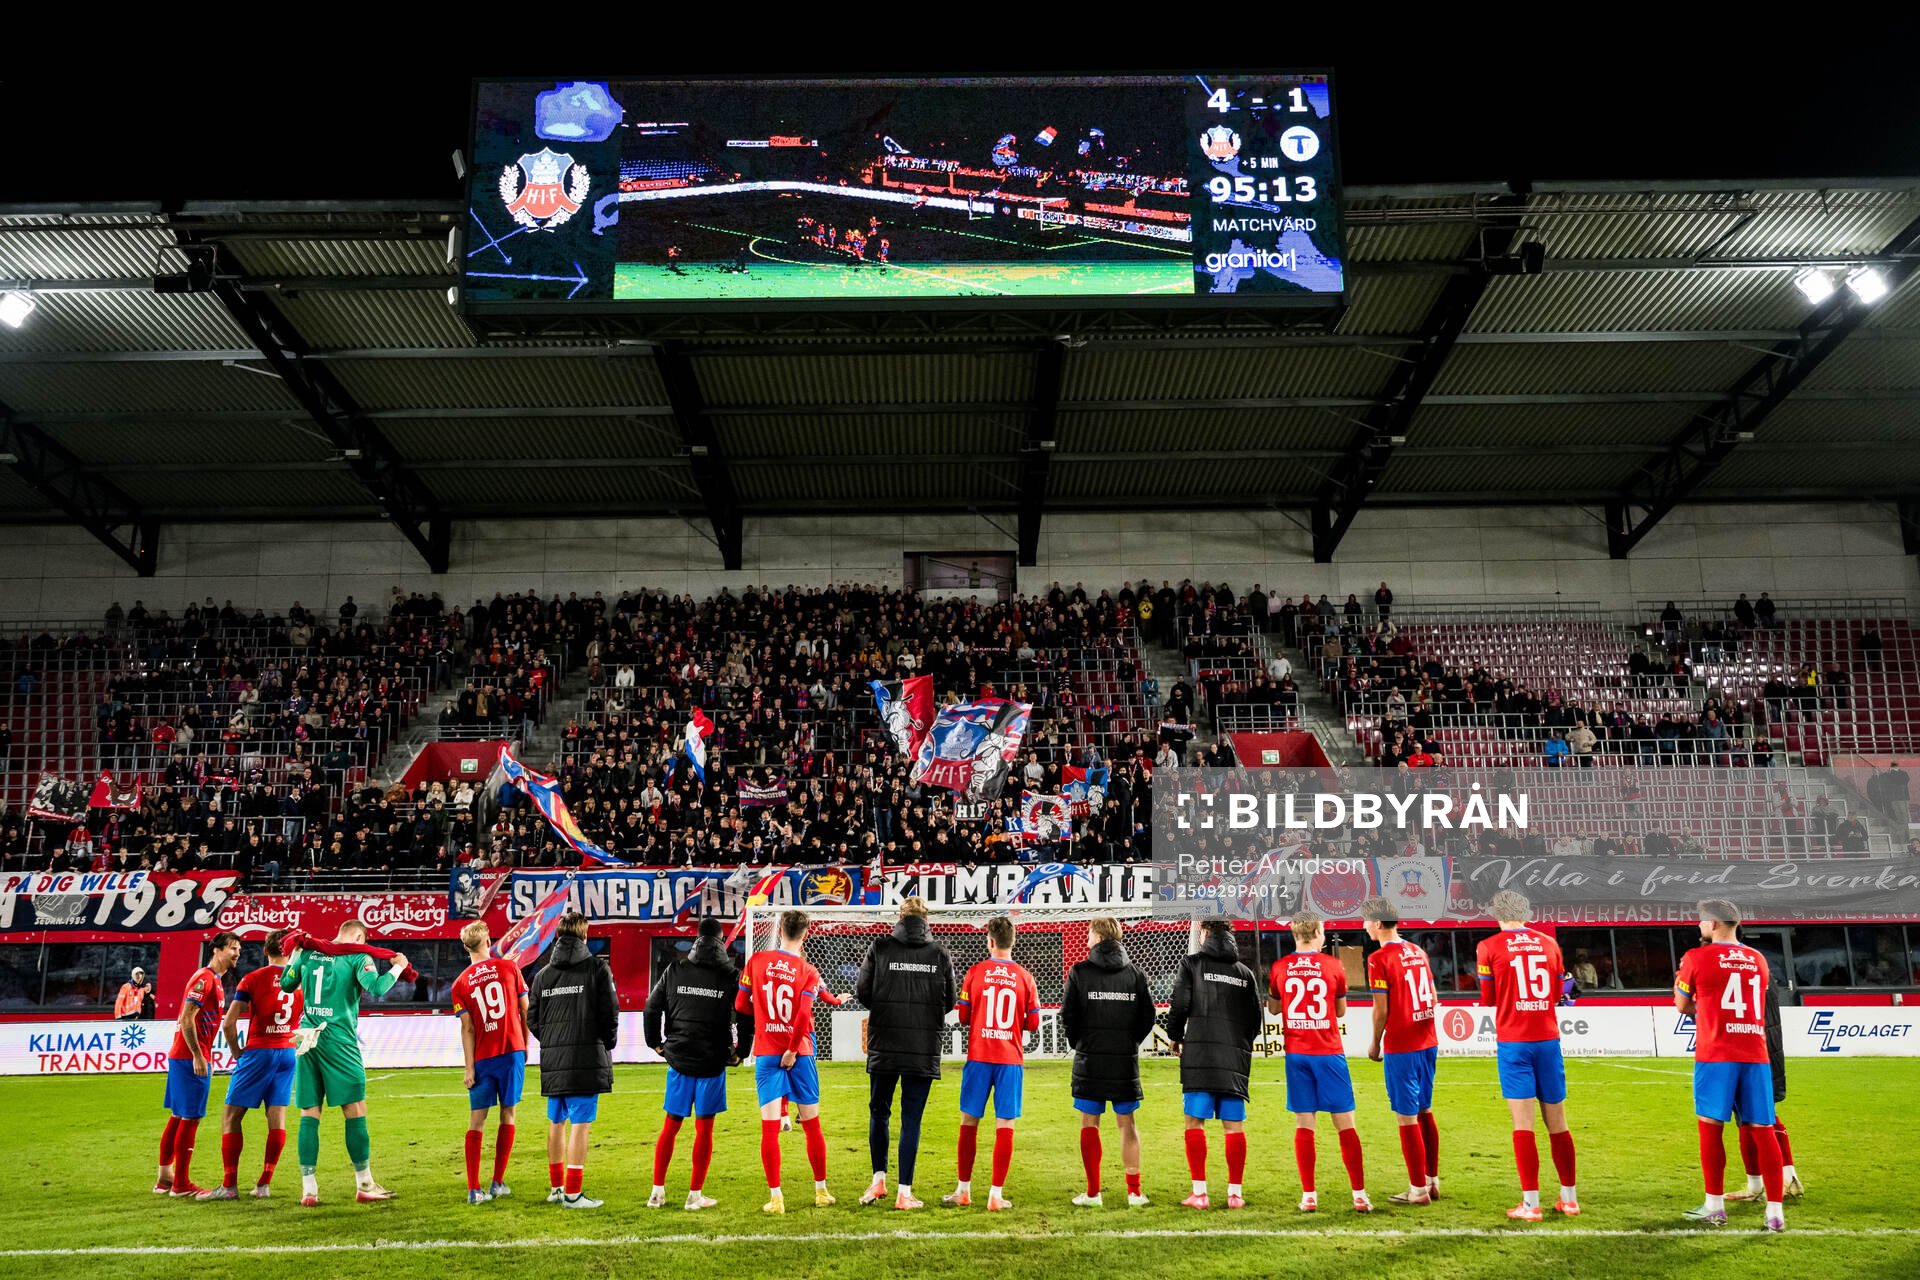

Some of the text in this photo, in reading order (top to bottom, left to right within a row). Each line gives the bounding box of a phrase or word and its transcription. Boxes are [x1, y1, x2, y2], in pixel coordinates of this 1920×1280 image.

[1207, 88, 1230, 113] 4
[1288, 87, 1308, 113] 1
[1261, 157, 1279, 169] MIN
[1209, 176, 1318, 203] 95:13
[1213, 216, 1317, 232] MATCHVÄRD
[956, 802, 987, 818] HIF
[906, 863, 957, 875] ACAB
[1470, 858, 1591, 889] Vila
[1607, 869, 1626, 886] i
[1640, 865, 1737, 896] frid
[4, 872, 146, 893] PÅ DIG WILLE
[93, 876, 237, 928] 1985
[358, 899, 446, 929] Carlsberg
[889, 962, 938, 973] HELSINGBORGS IF
[1509, 955, 1550, 999] 15
[312, 966, 324, 1004] 1
[1203, 972, 1248, 988] HELSINGBORGS IF
[1404, 966, 1433, 1012] 14
[470, 981, 506, 1023] 19
[541, 985, 585, 998] HELSINGBORGS IF
[676, 985, 724, 999] HELSINGBORGS IF
[762, 980, 794, 1024] 16
[1088, 991, 1136, 1001] HELSINGBORGS IF
[1285, 977, 1328, 1020] 23
[1720, 972, 1762, 1020] 41
[274, 991, 295, 1025] 3
[983, 985, 1017, 1030] 10
[265, 1025, 292, 1034] NILSSON
[981, 1028, 1013, 1040] SVENSSON
[1286, 1019, 1330, 1030] WESTERLUND
[1836, 1024, 1913, 1037] BOLAGET
[29, 1032, 116, 1052] KLIMAT
[37, 1051, 168, 1072] TRANSPOR
